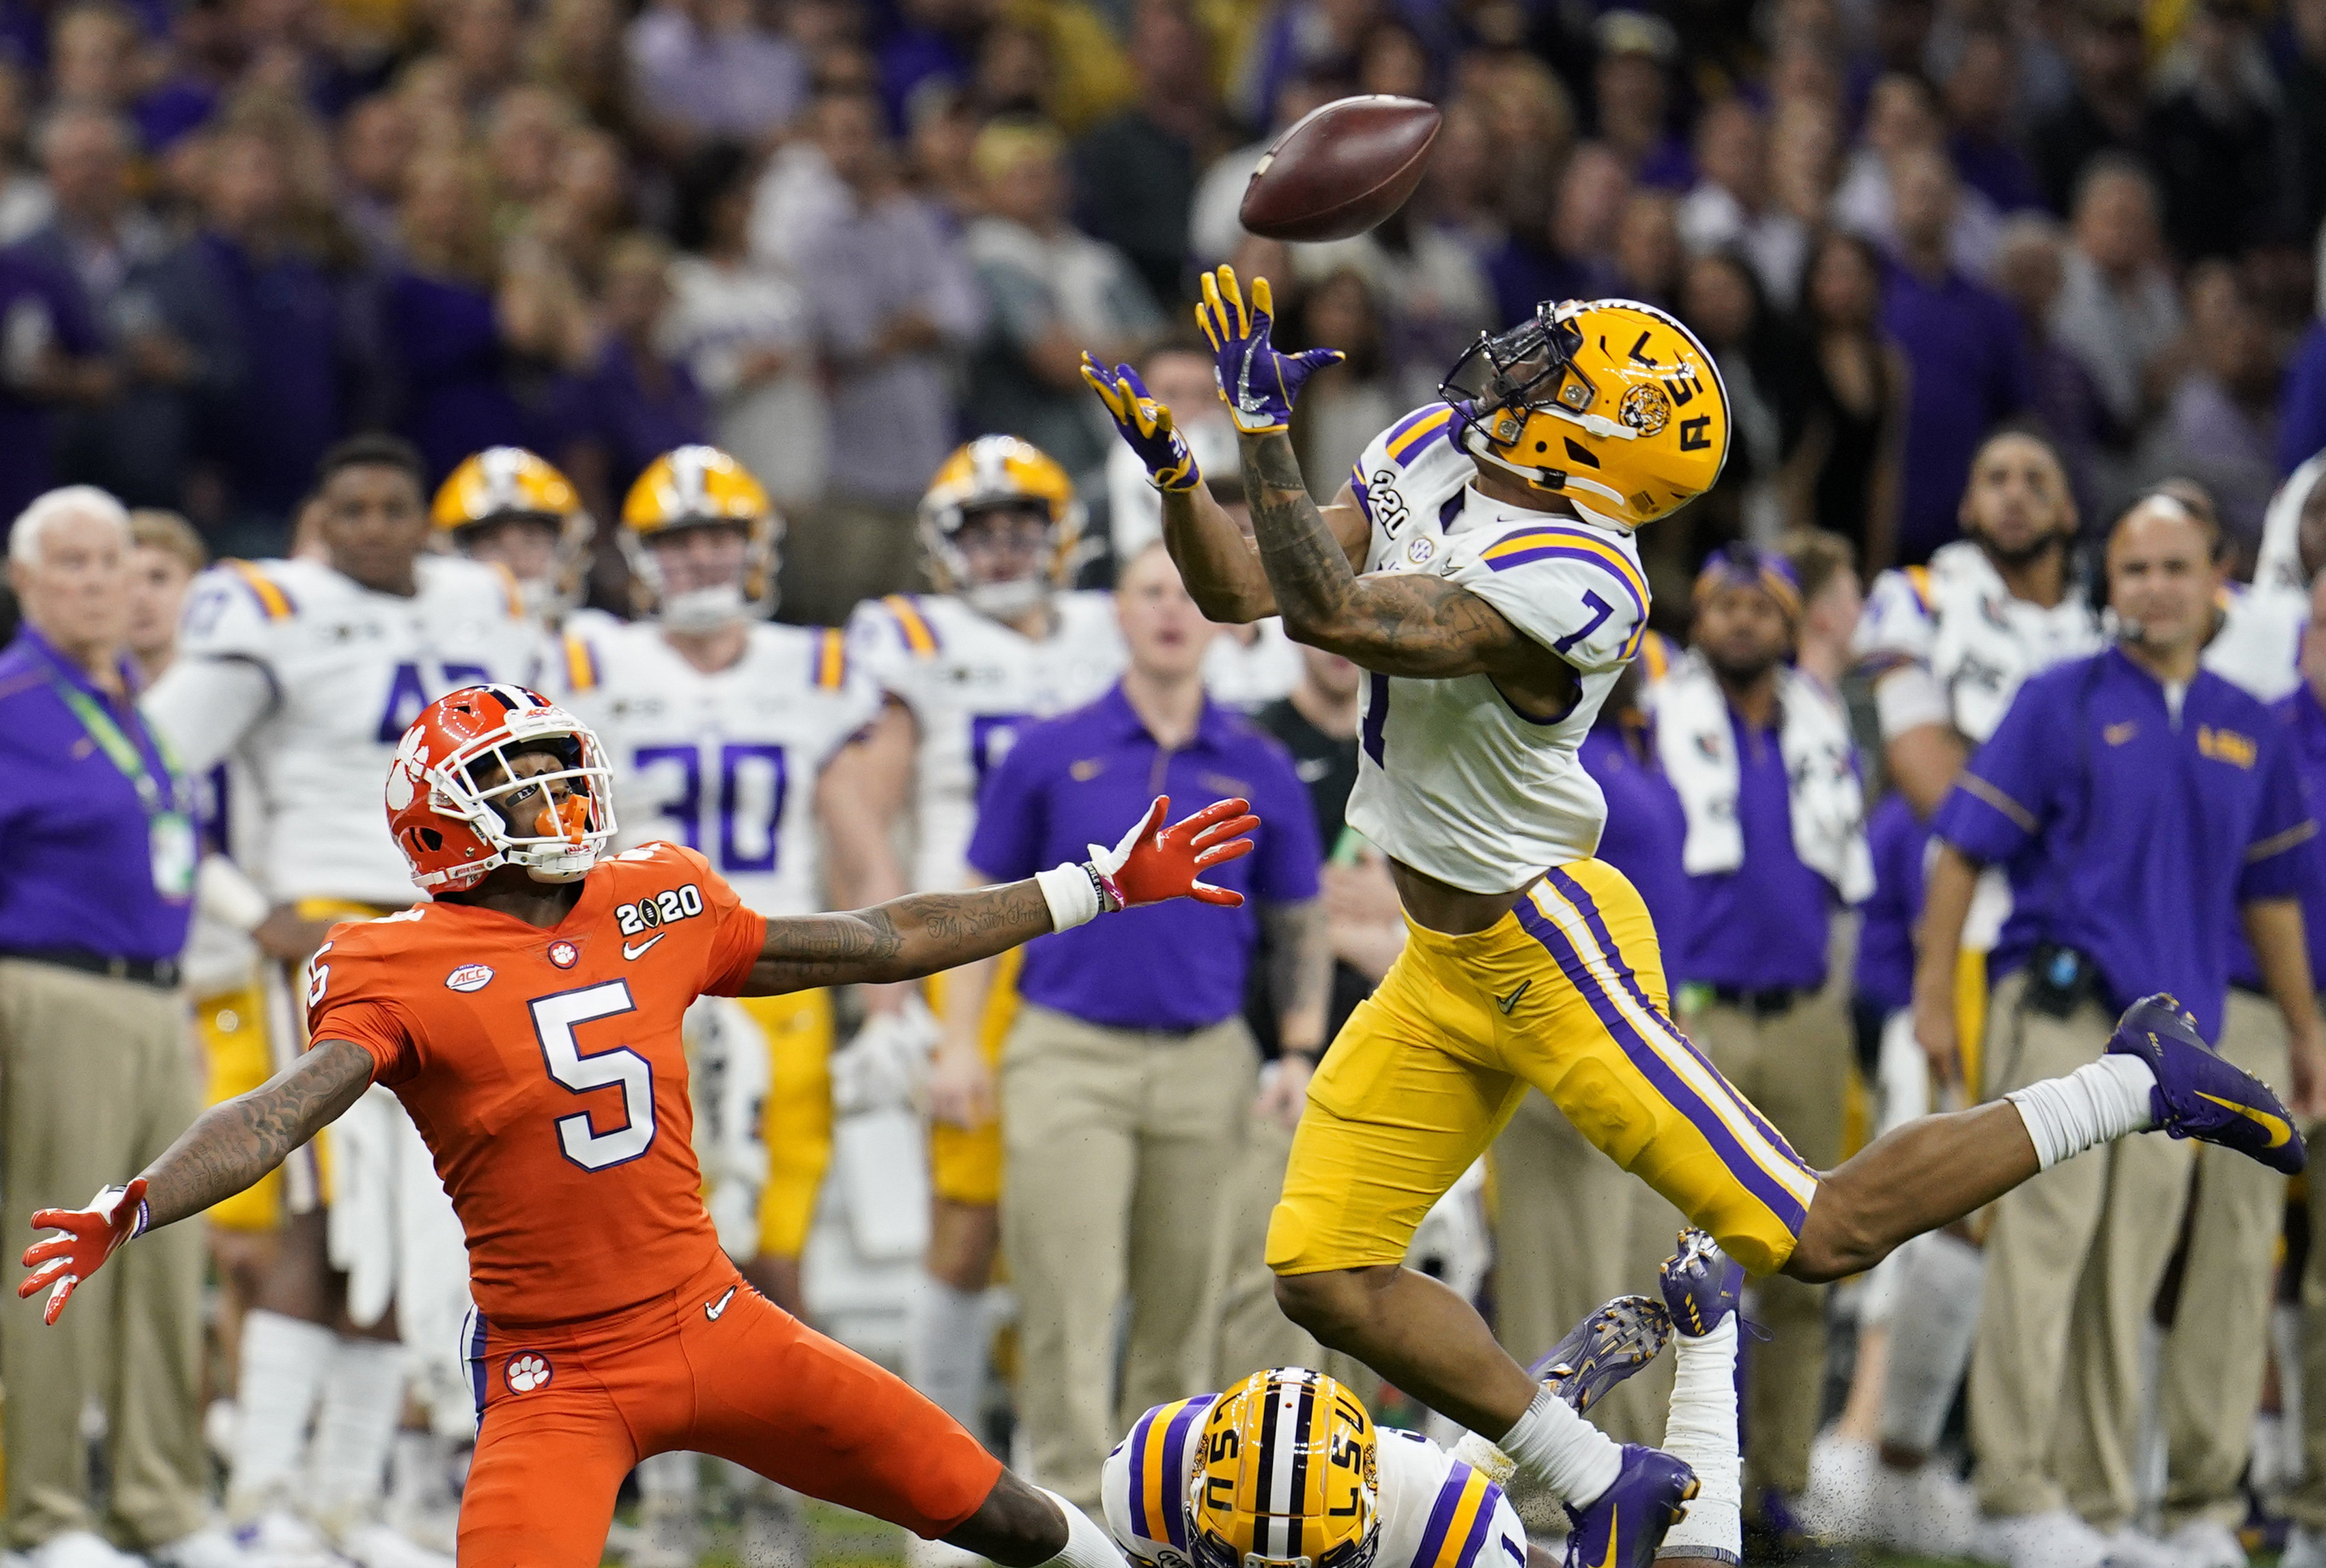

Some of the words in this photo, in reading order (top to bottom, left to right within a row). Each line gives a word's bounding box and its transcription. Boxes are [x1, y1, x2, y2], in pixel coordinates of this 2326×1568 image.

[1628, 330, 1711, 452] LSU
[1553, 588, 1615, 655] 7
[635, 742, 788, 873] 30
[453, 968, 487, 985] ACC
[526, 976, 657, 1174] 5
[1205, 1393, 1243, 1512] LSU
[1329, 1396, 1364, 1517] LSU
